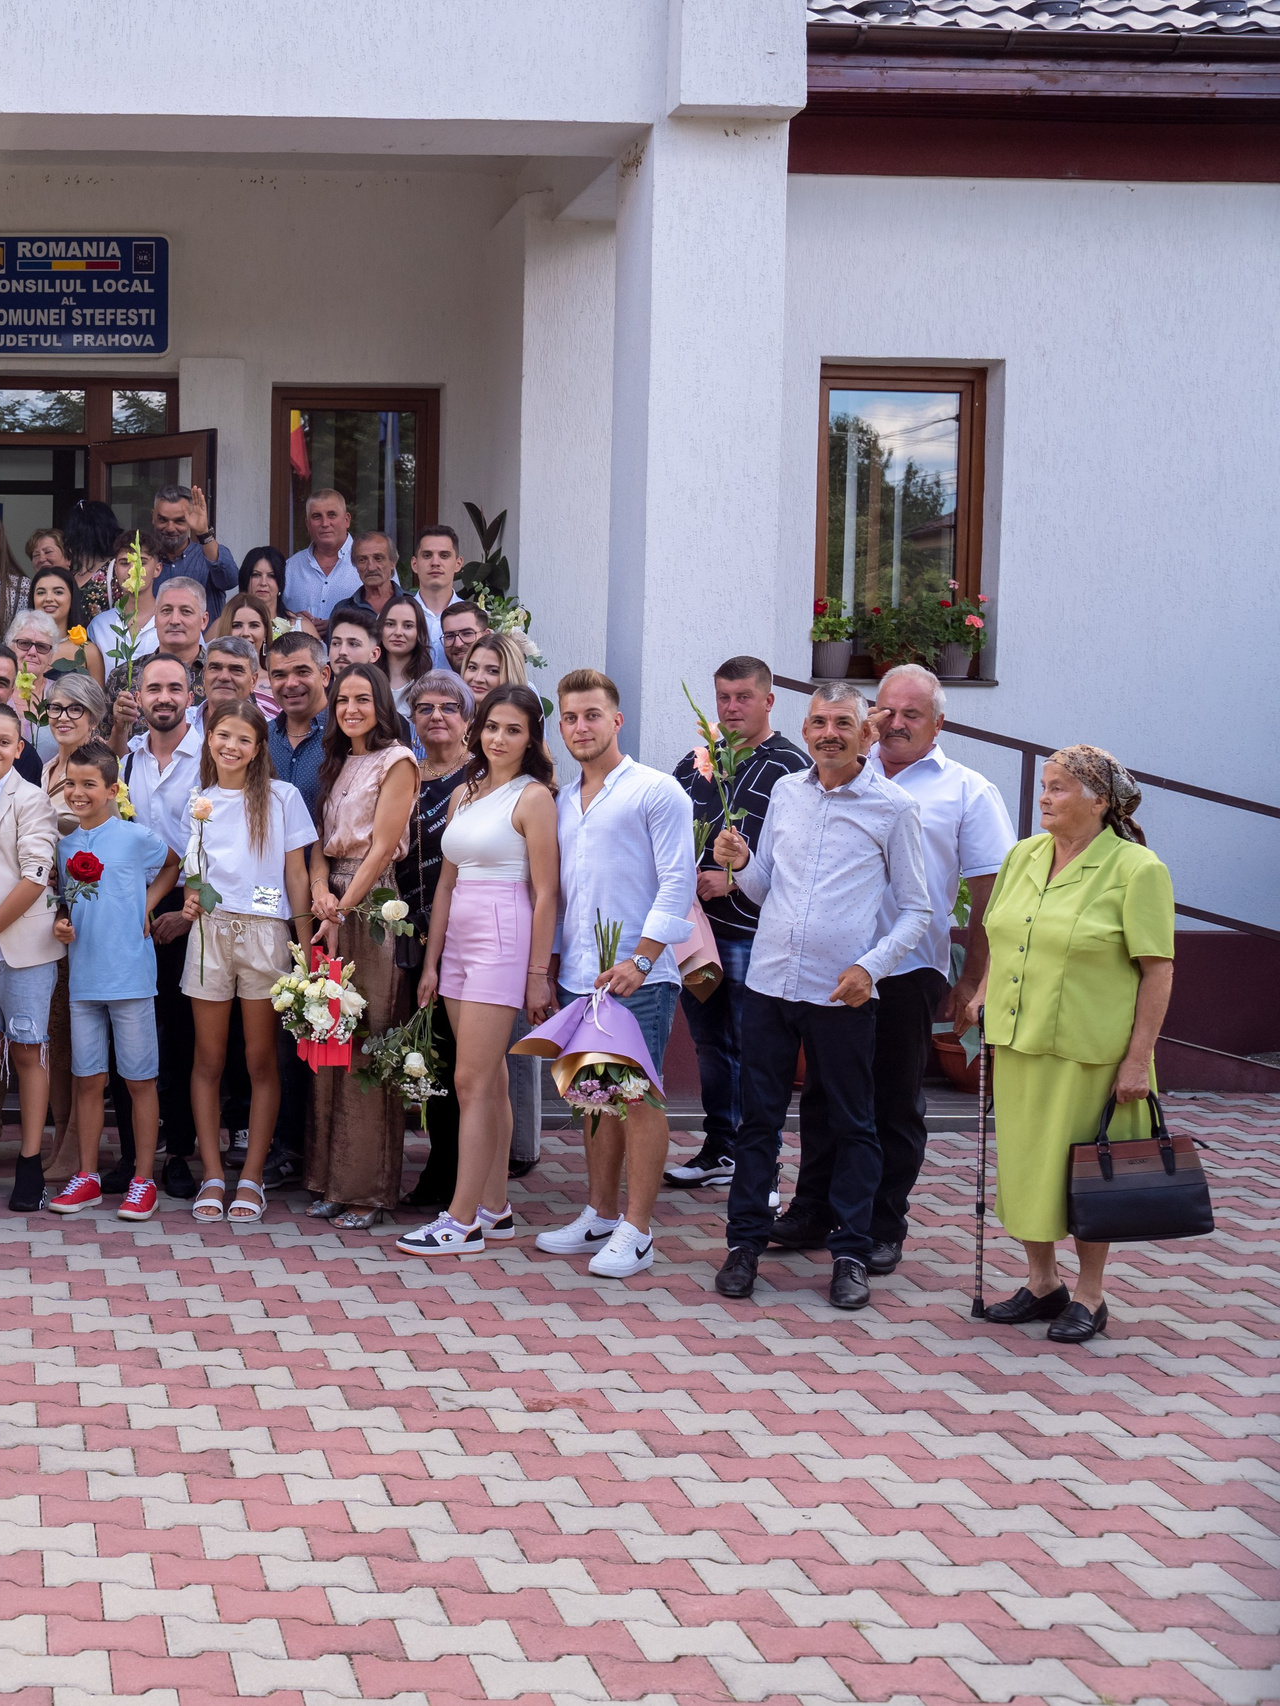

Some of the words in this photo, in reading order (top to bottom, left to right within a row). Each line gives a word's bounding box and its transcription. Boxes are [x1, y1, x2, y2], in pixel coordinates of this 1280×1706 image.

[17, 241, 122, 258] ROMANIA
[92, 279, 155, 293] LOCAL
[61, 296, 77, 306] AL
[71, 308, 156, 326] STEFESTI
[72, 334, 156, 347] PRAHOVA
